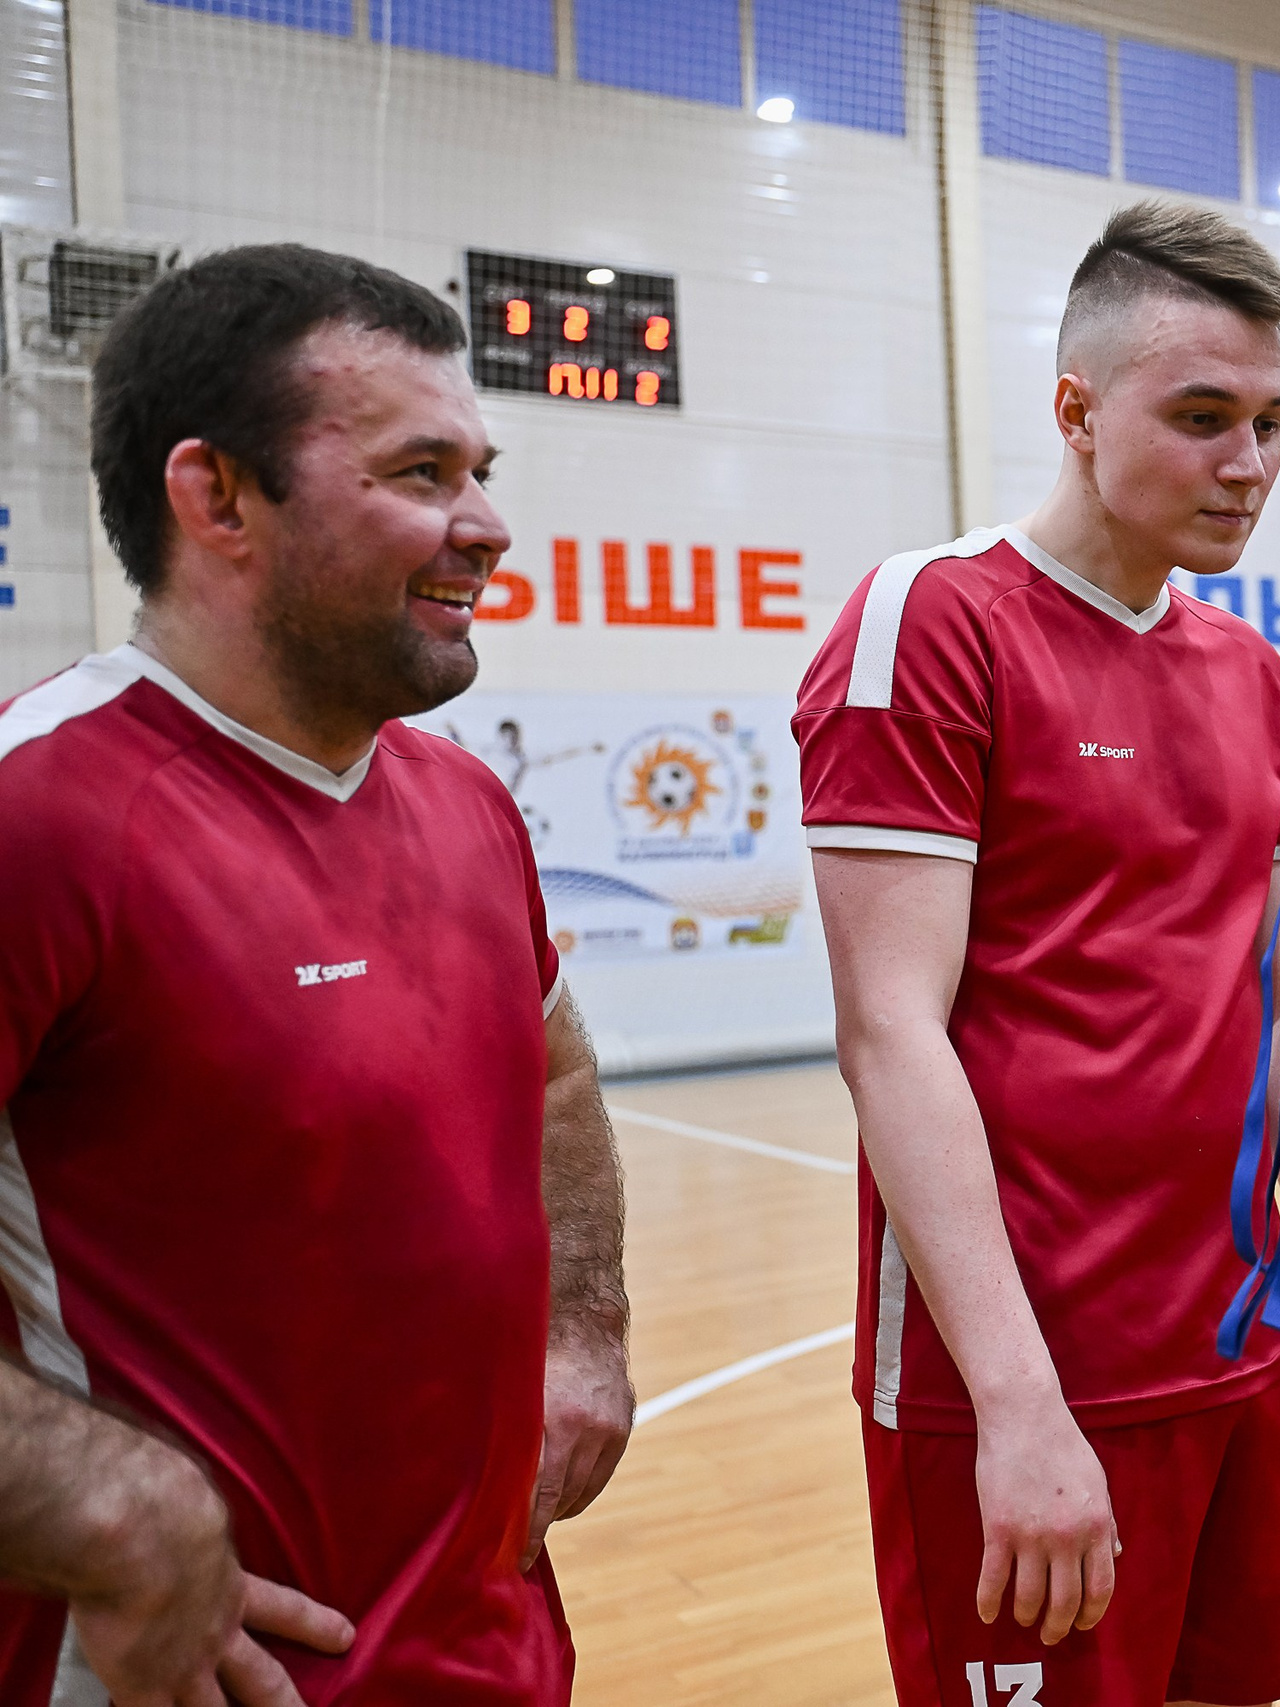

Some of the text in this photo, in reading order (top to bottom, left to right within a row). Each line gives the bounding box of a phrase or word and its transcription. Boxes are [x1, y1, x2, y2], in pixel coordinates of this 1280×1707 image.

[506, 299, 531, 335] 3
[563, 305, 589, 342] 2
[644, 316, 671, 351] 2
[635, 371, 660, 406] 2
[473, 537, 806, 631] ЫШЕ
[1078, 742, 1135, 759] 2K SPORT
[294, 960, 368, 987] 2K SPORT
